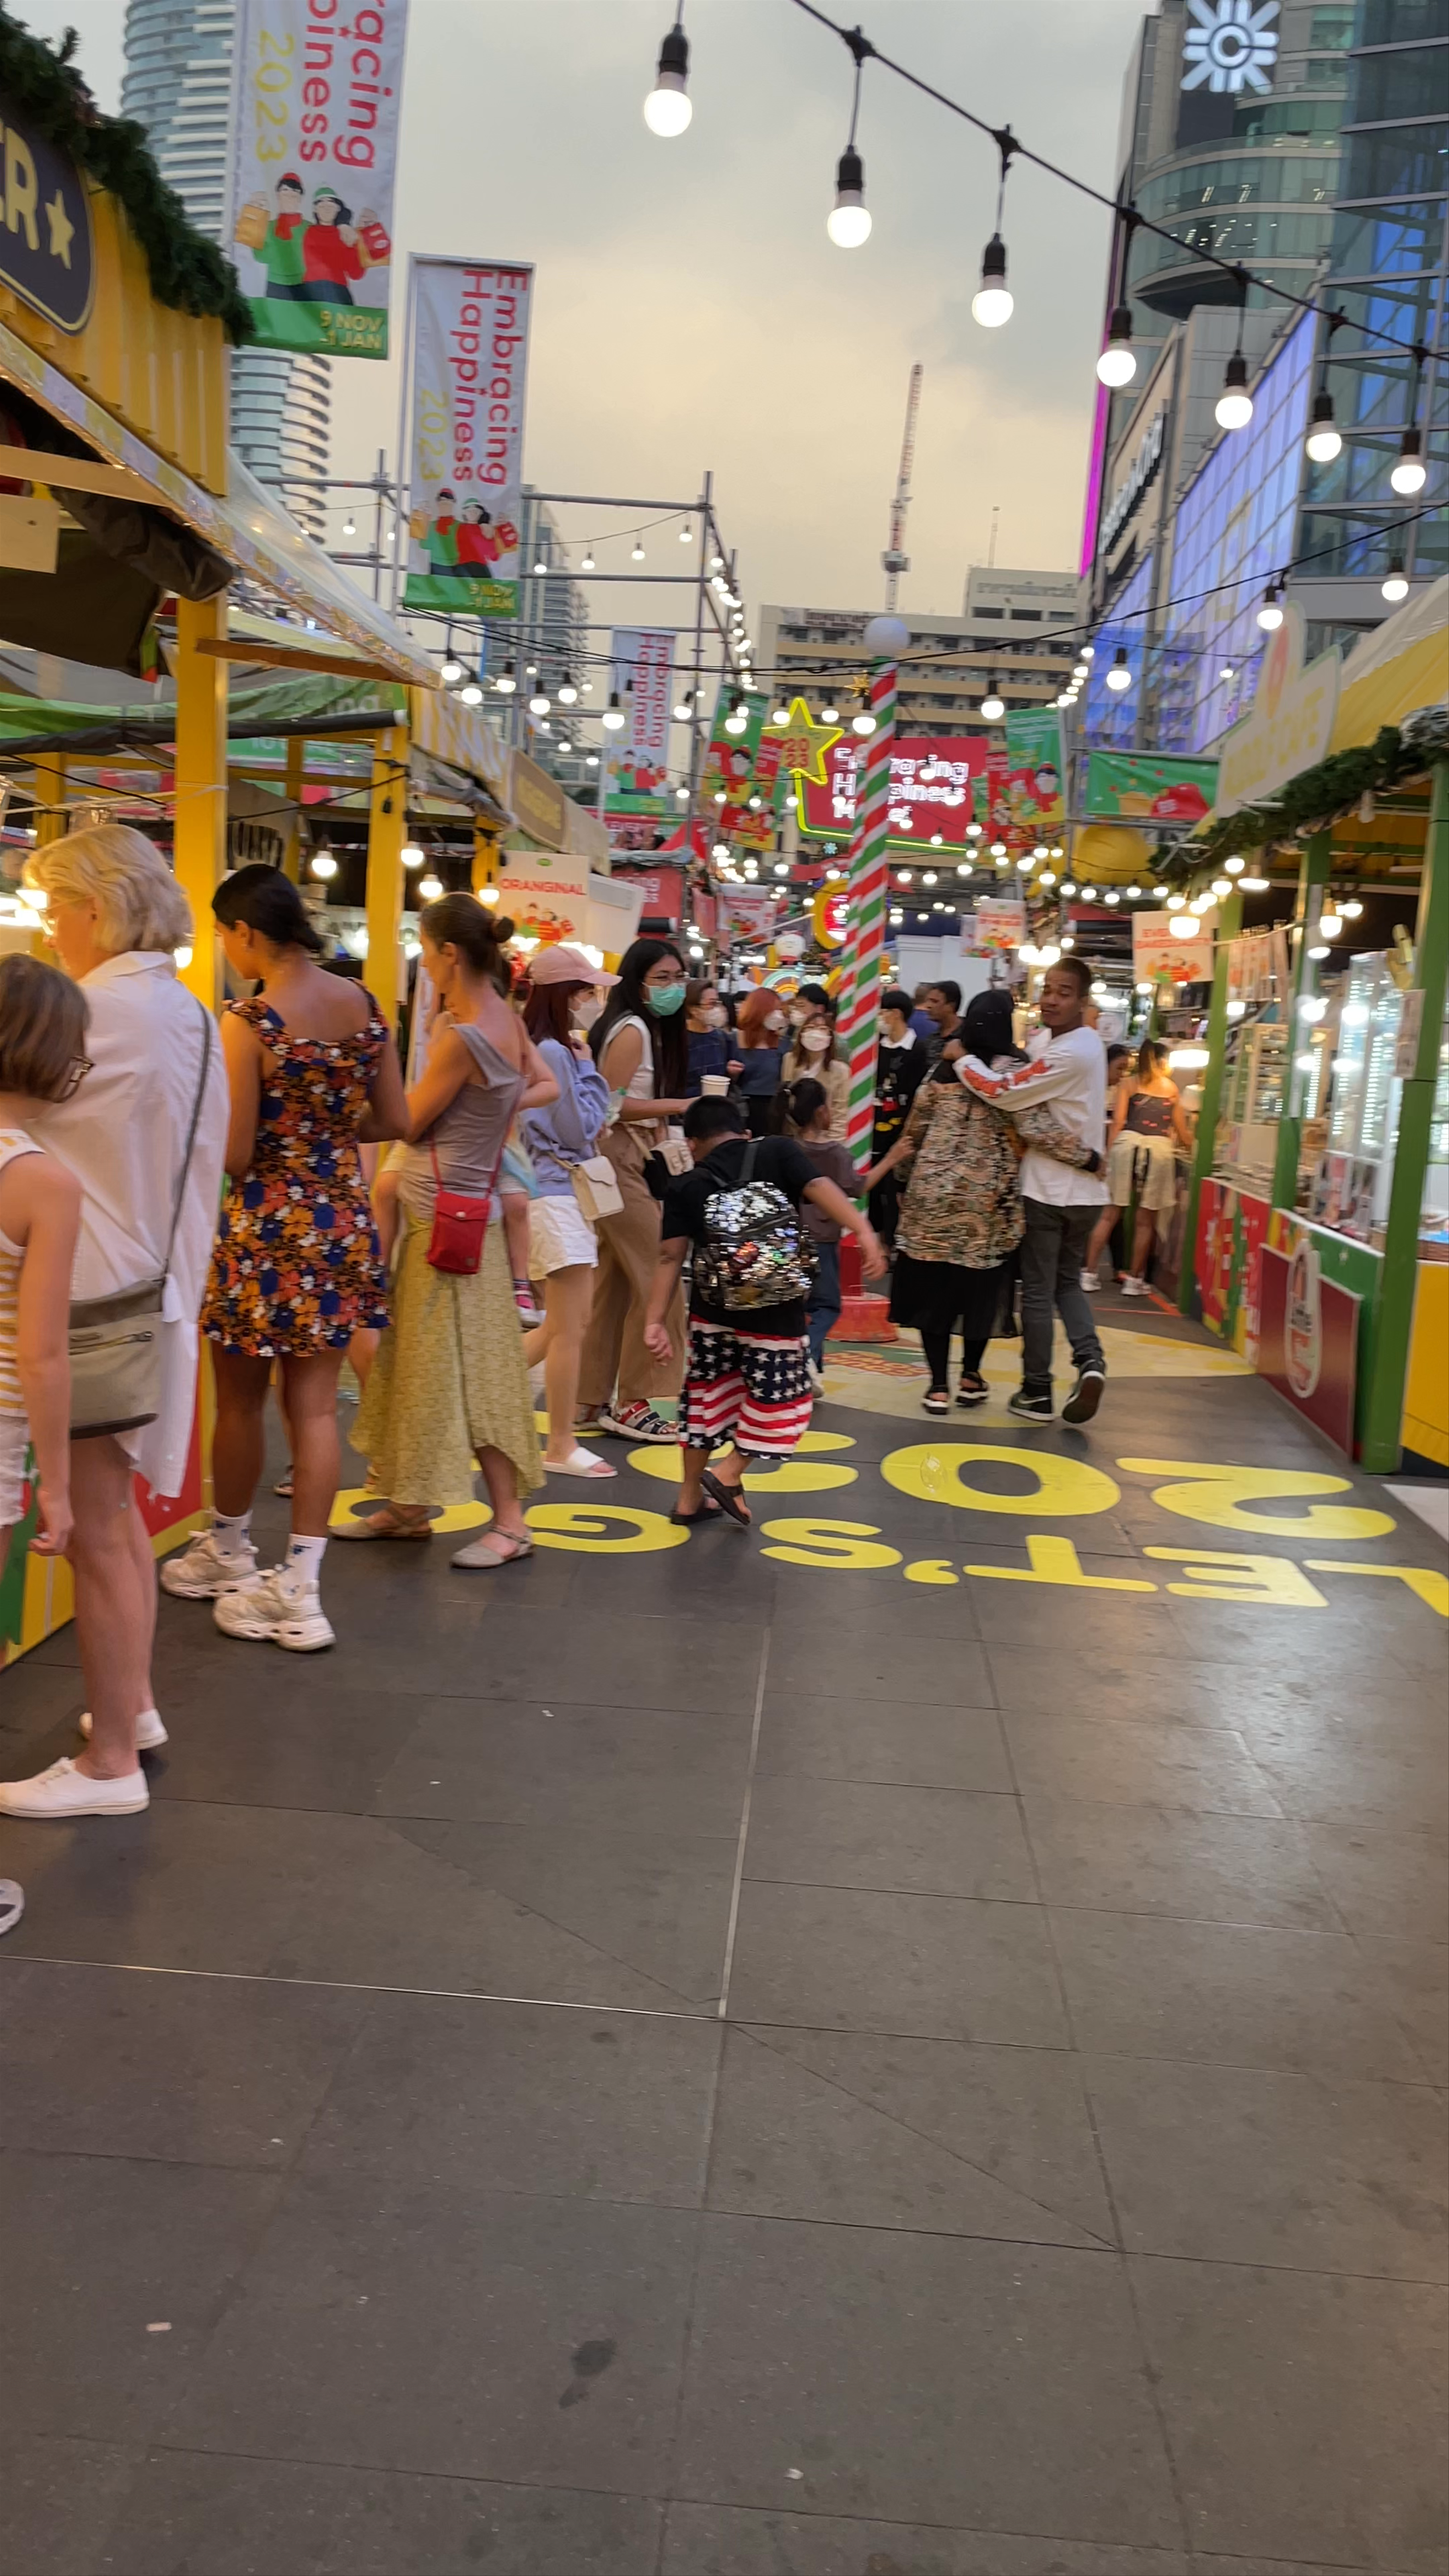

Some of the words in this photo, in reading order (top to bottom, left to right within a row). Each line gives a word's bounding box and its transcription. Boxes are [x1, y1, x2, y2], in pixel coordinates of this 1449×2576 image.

[255, 30, 295, 162] 2023
[418, 389, 449, 480] 2023
[448, 269, 493, 481] Happiness
[477, 270, 527, 485] Embracing
[632, 634, 656, 745] Happiness
[648, 635, 675, 747] Embracing
